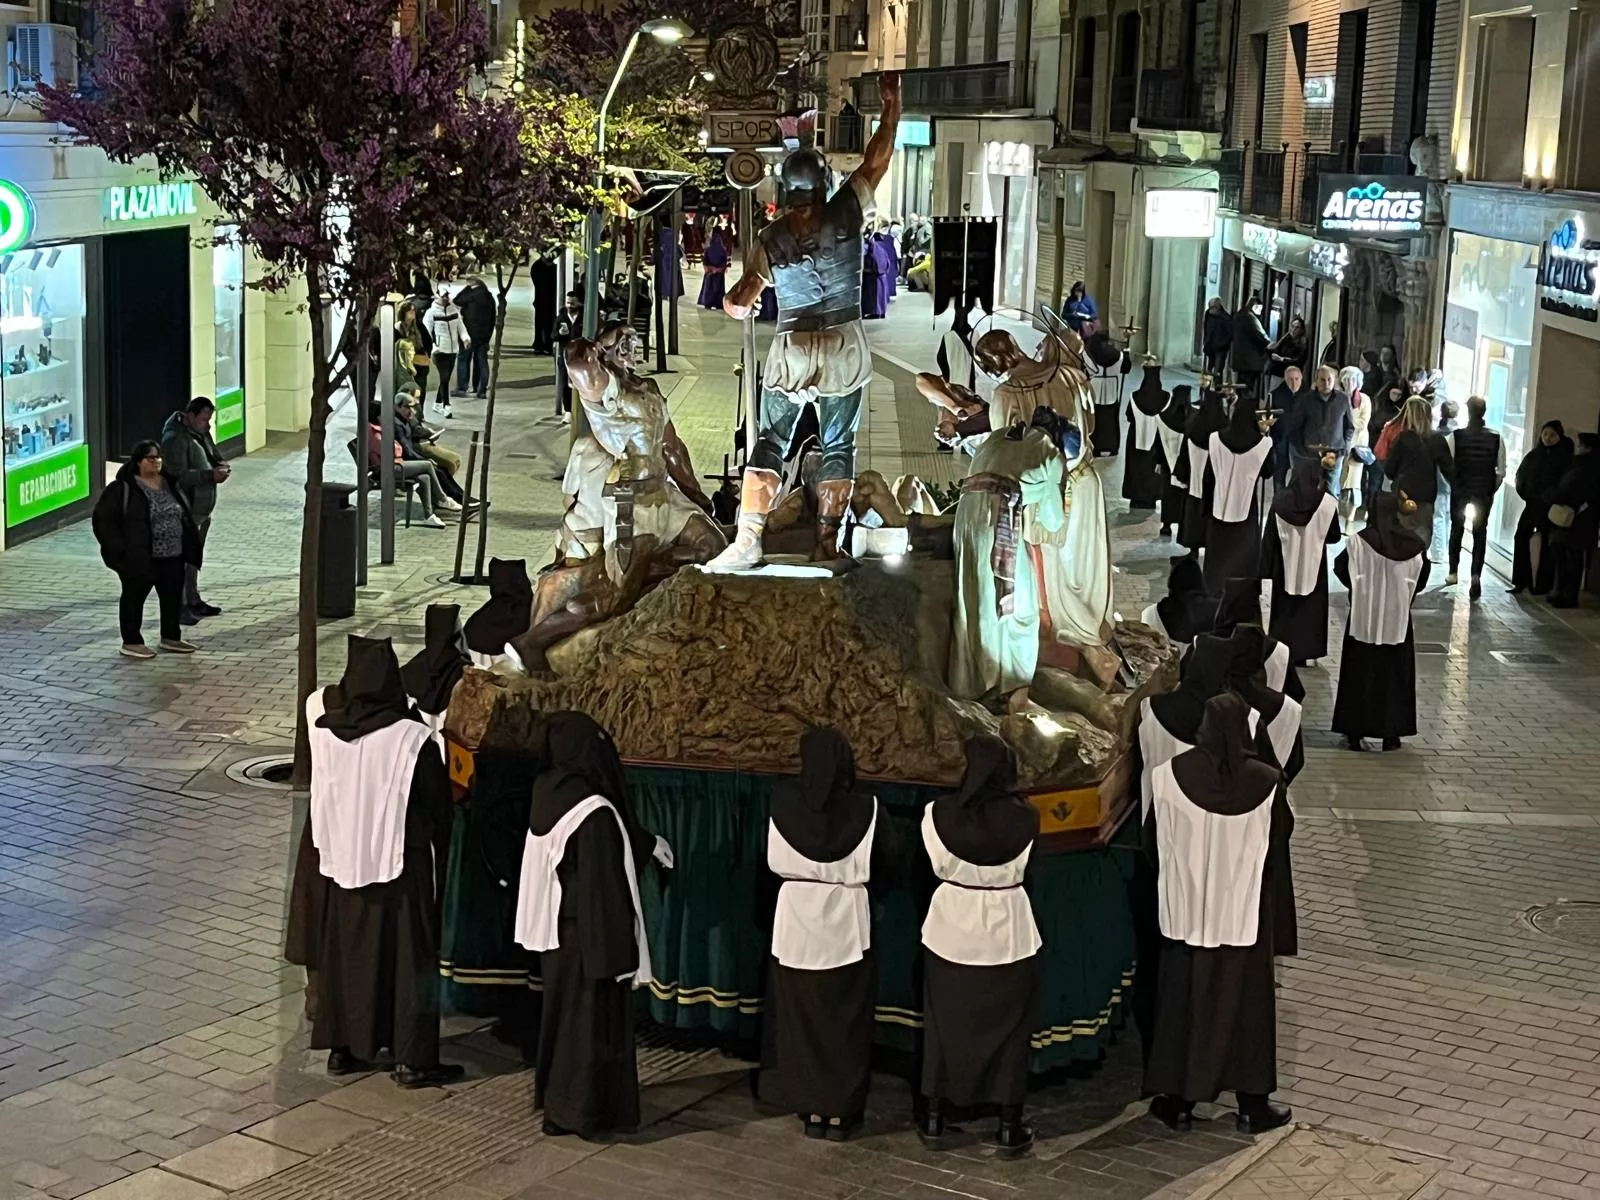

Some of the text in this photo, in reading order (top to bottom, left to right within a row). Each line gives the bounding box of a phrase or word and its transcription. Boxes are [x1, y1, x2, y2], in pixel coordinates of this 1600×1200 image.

[716, 119, 774, 141] SPQR
[110, 182, 198, 221] PLAZAMOVIL
[1322, 191, 1423, 219] Arenas
[1536, 241, 1599, 295] Arenas
[19, 463, 77, 506] REPARACIONES
